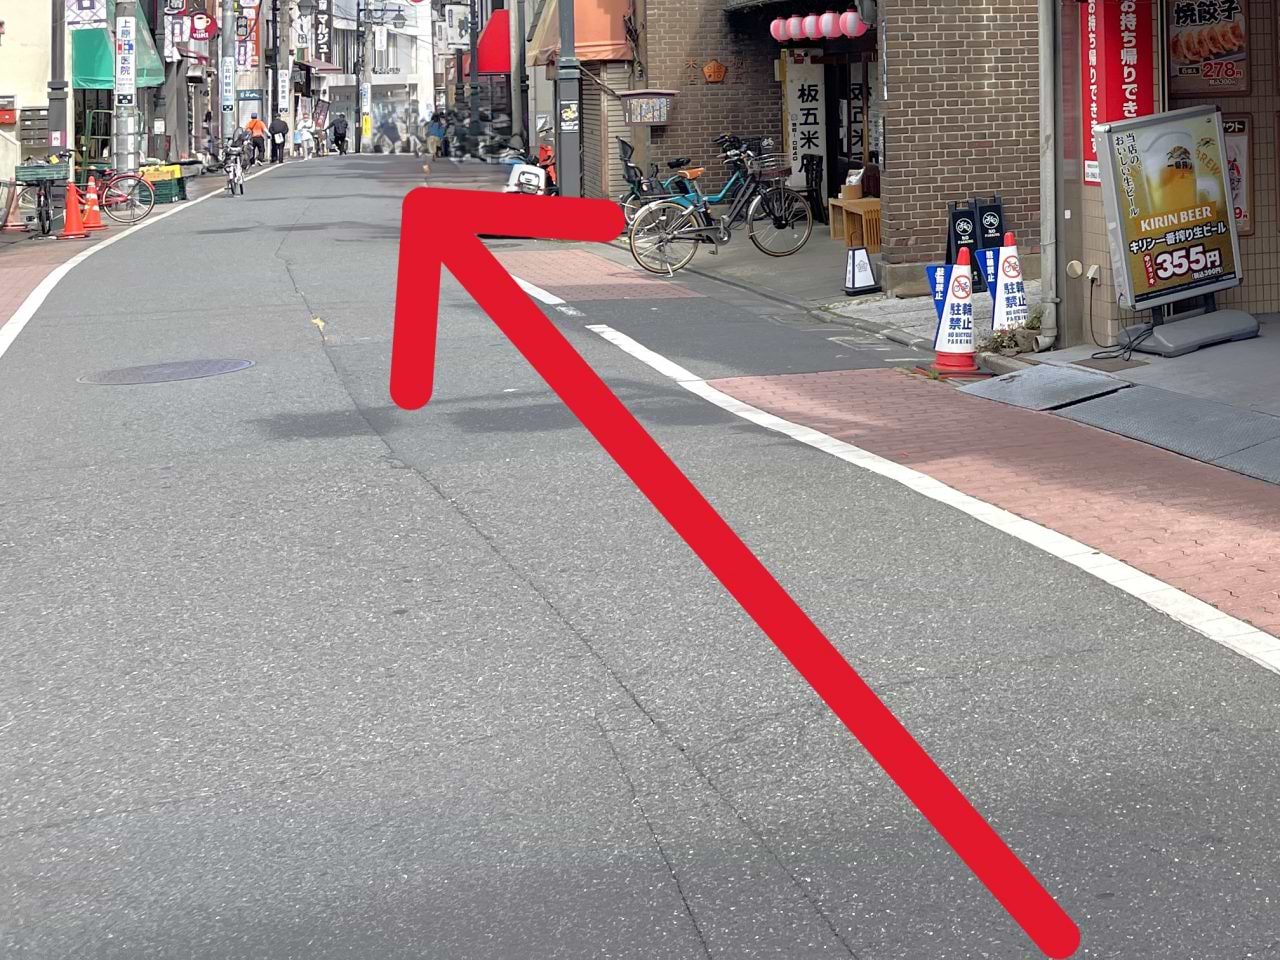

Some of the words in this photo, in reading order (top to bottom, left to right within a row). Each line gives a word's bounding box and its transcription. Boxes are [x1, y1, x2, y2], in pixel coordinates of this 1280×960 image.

[1115, 136, 1139, 219] おいしい生ビール
[1140, 213, 1179, 232] KIRIN
[1180, 206, 1212, 224] BEER
[1130, 222, 1226, 254] キリン一番搾り生ビール
[1156, 245, 1221, 279] 355円
[1004, 281, 1025, 295] 駐輪
[950, 302, 973, 316] 駐輪
[1005, 296, 1027, 308] 禁止
[949, 317, 973, 330] 禁止
